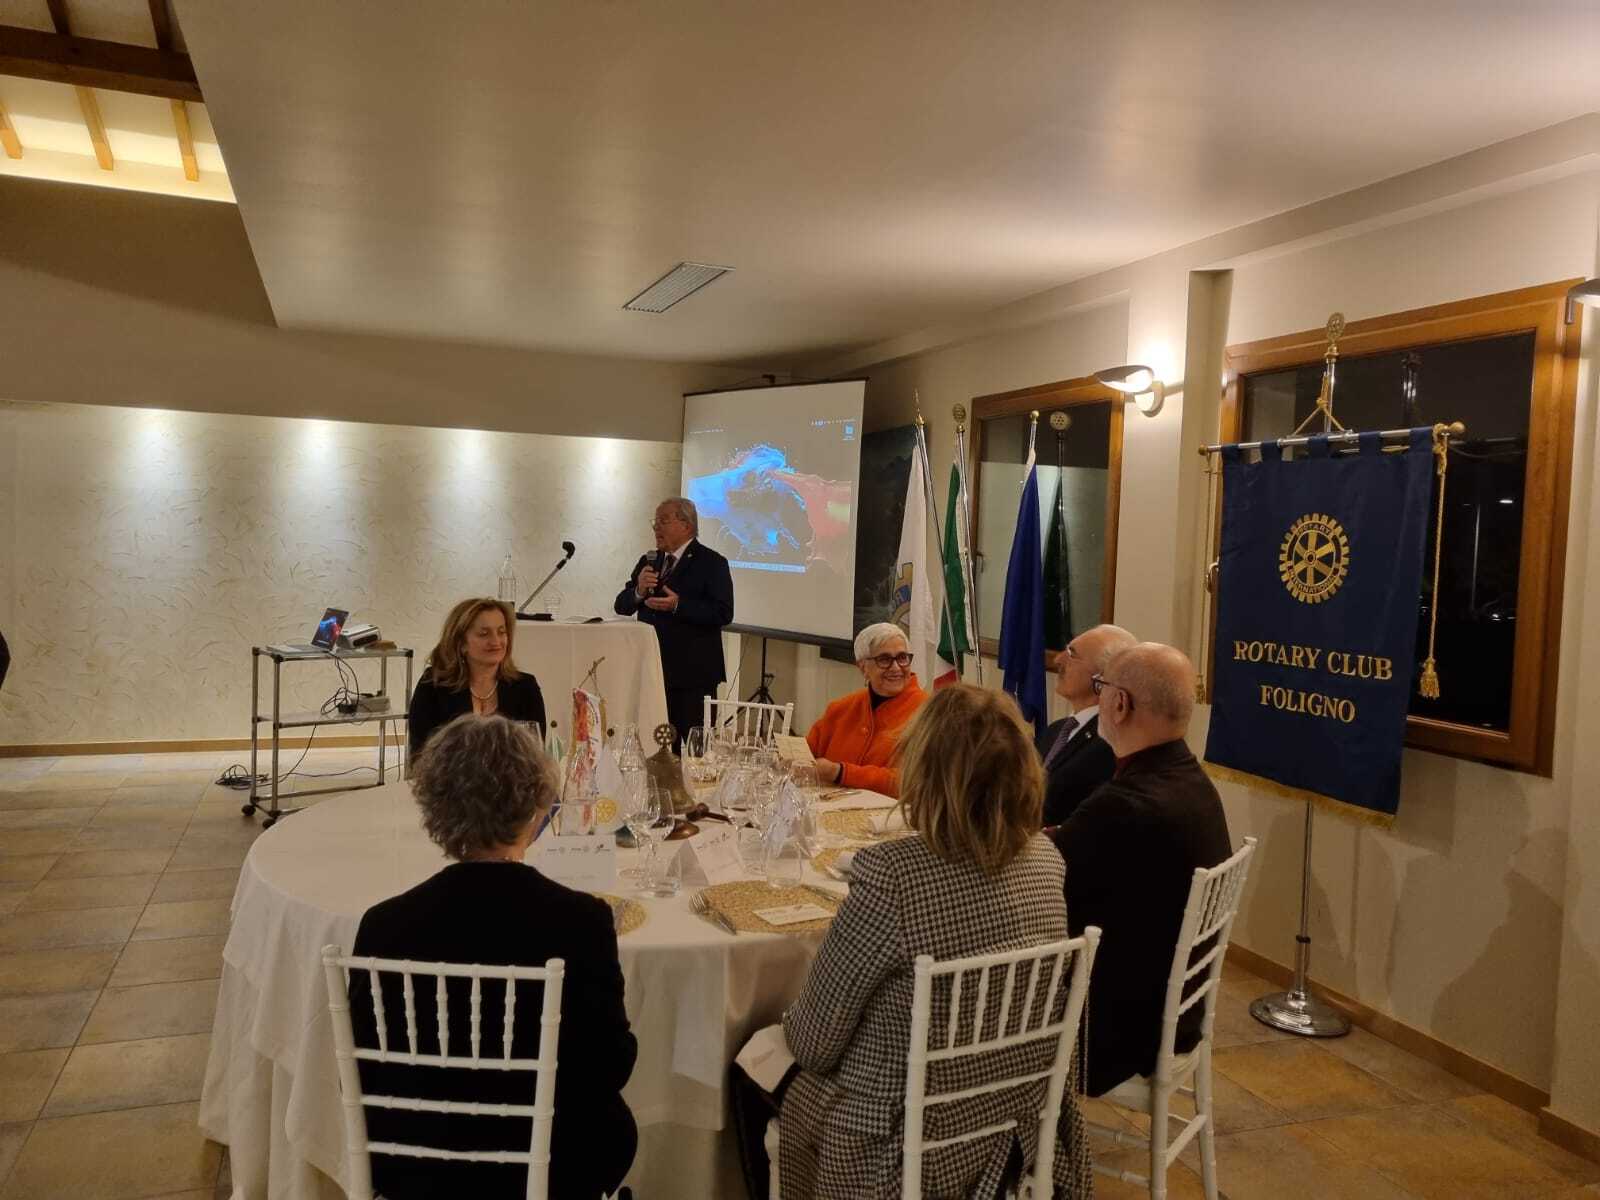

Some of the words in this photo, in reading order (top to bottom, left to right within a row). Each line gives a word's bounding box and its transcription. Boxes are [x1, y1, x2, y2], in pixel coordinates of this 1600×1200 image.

[1233, 640, 1321, 669] ROTARY
[1327, 651, 1393, 681] CLUB
[1259, 685, 1356, 723] FOLIGNO
